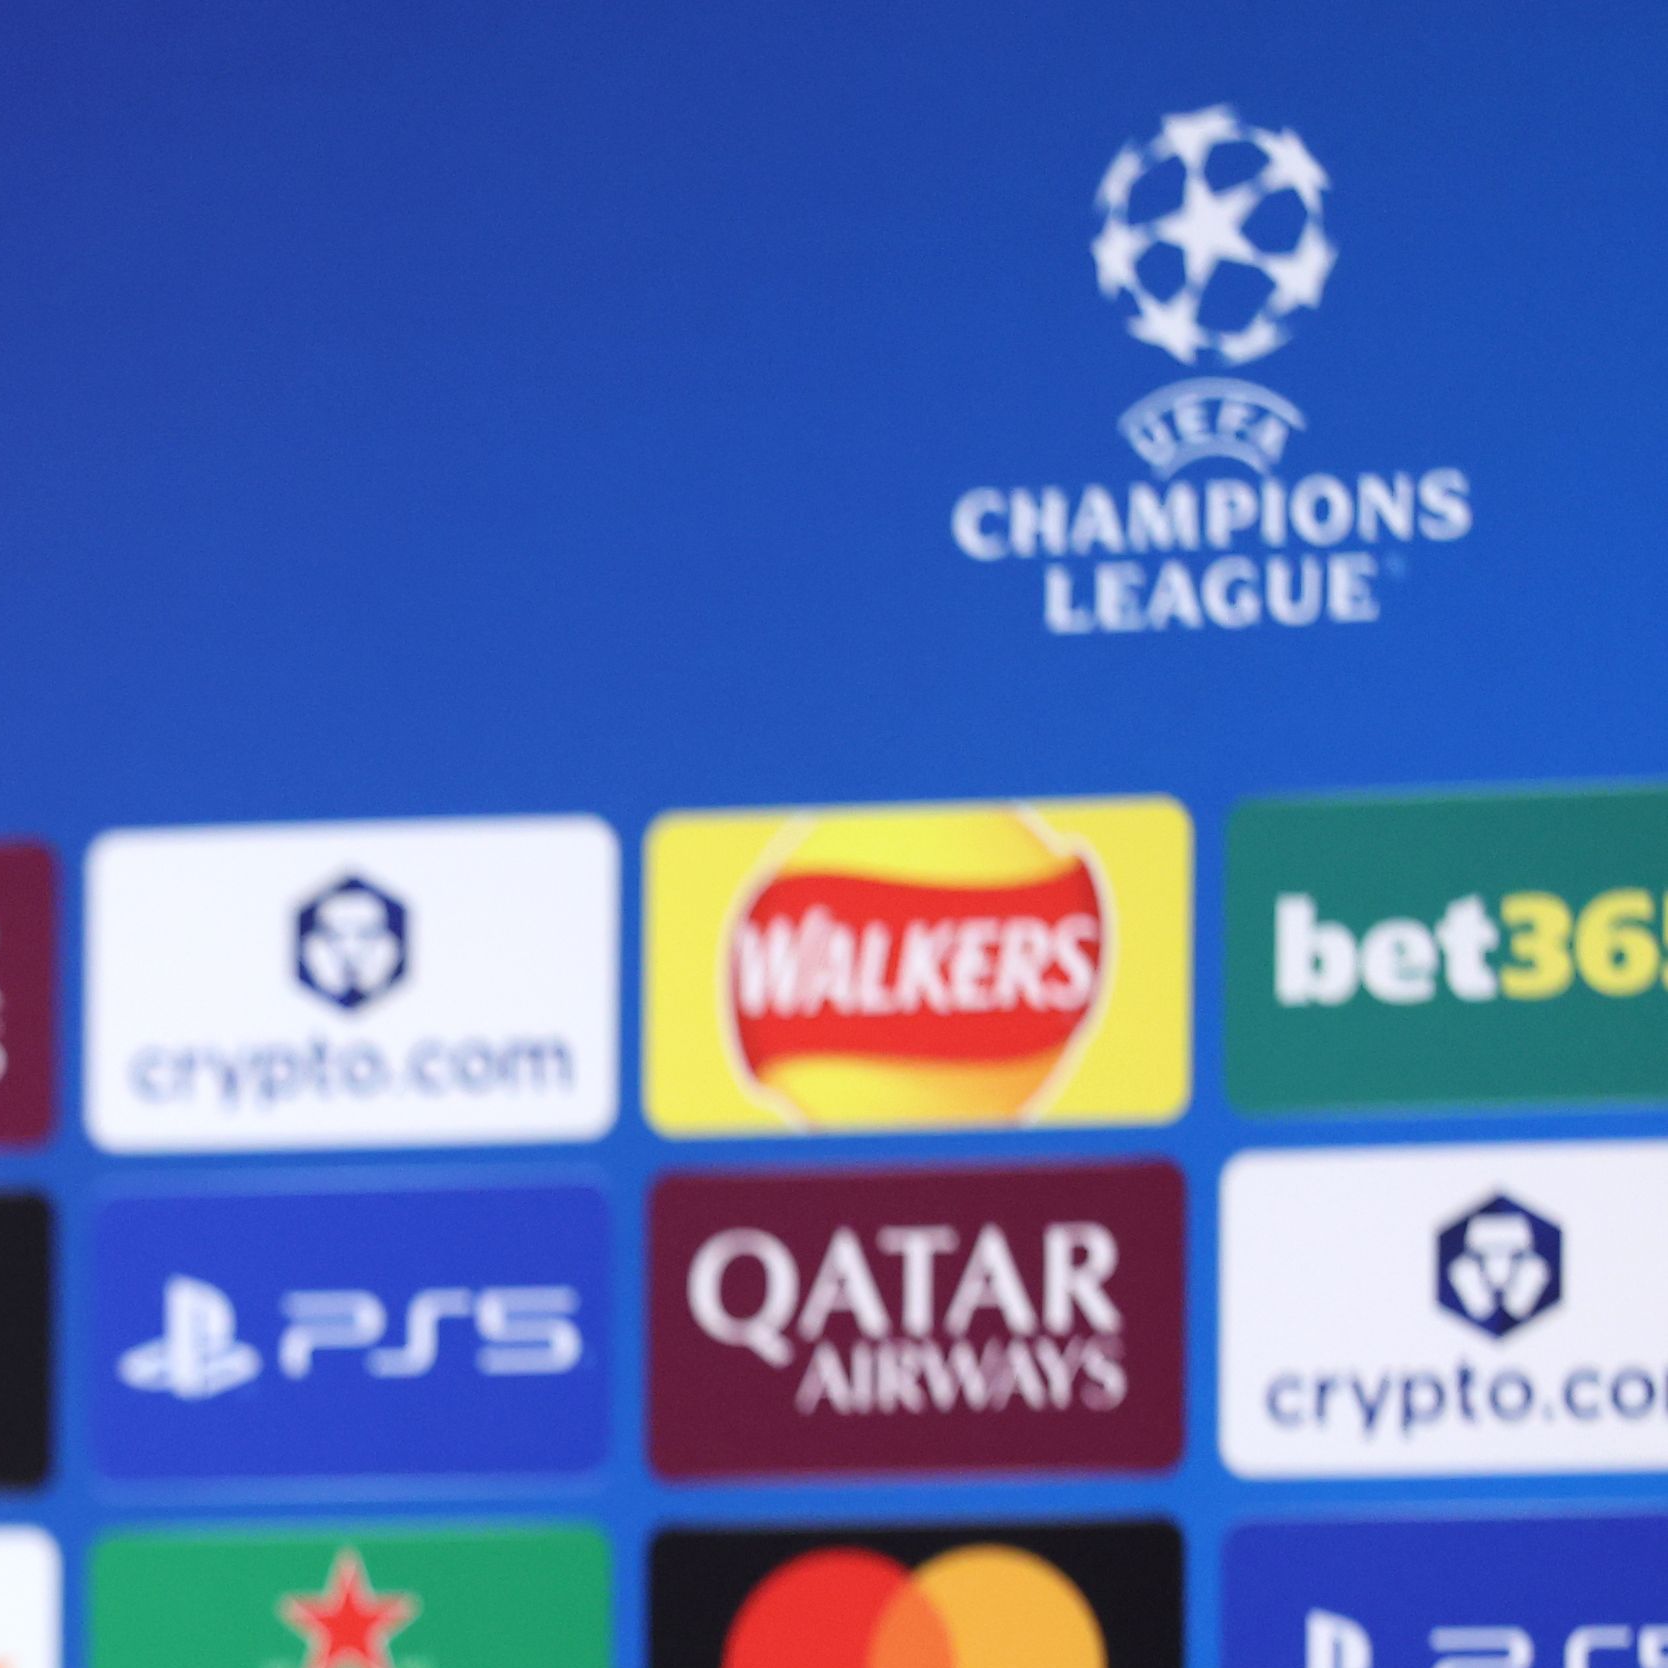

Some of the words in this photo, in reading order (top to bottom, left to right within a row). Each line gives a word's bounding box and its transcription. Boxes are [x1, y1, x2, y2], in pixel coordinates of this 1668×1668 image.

[951, 467, 1472, 562] CHAMPIONS
[1044, 551, 1380, 635] LEAGUE
[734, 905, 1104, 1017] WALKERS
[1274, 885, 1668, 1006] bet36
[129, 1032, 574, 1110] crypto.com
[277, 1285, 582, 1380] PS5
[686, 1222, 1122, 1368] QATAR
[796, 1335, 1128, 1415] AIRWAYS
[1264, 1358, 1668, 1445] crypto.co
